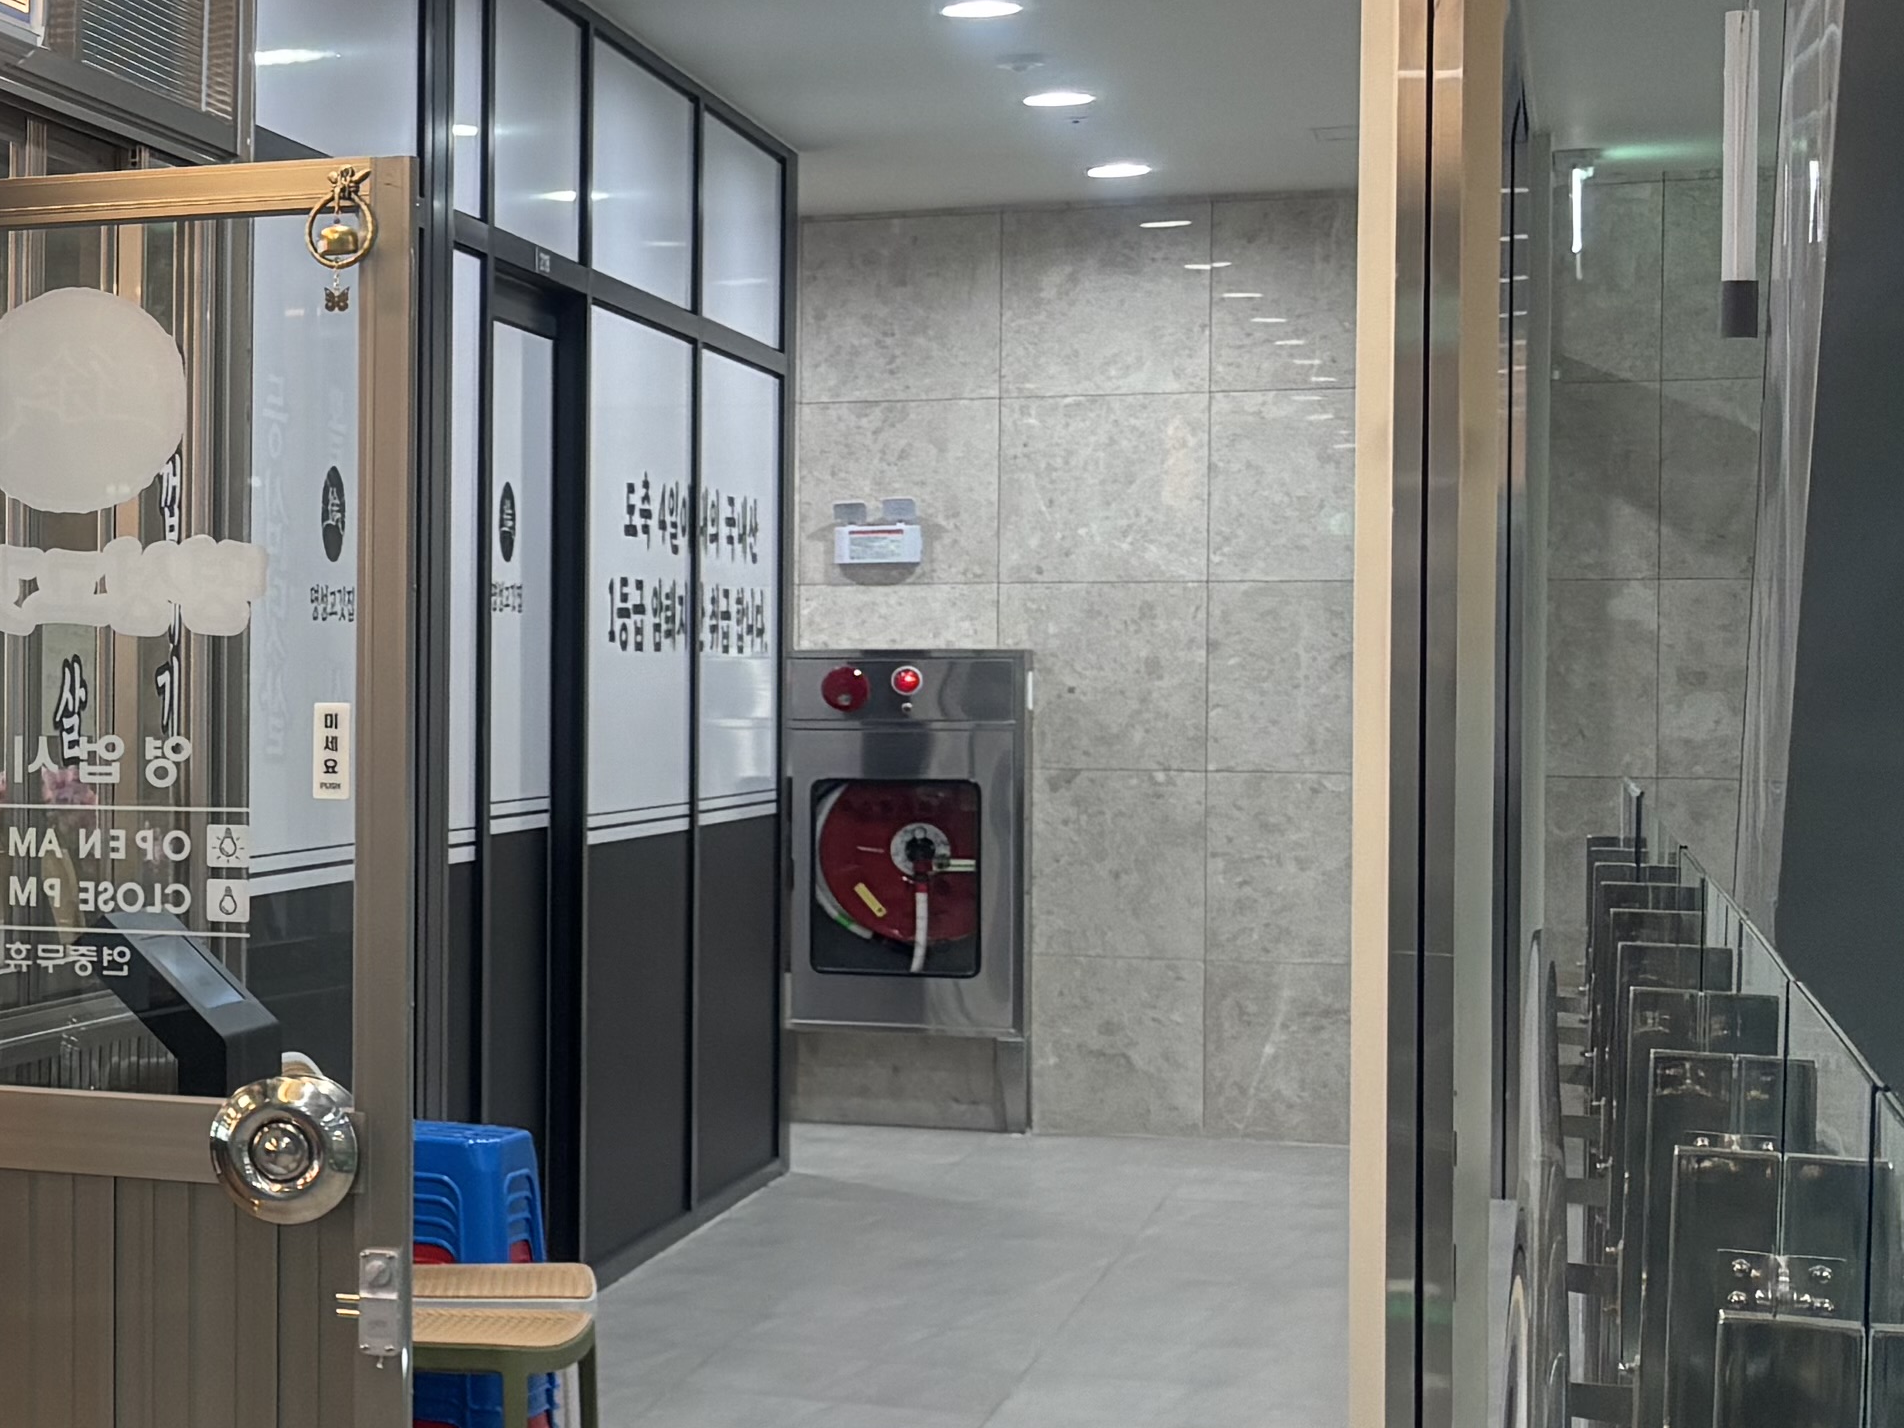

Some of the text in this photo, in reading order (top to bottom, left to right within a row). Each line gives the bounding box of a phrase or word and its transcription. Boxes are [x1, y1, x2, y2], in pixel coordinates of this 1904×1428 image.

[624, 471, 653, 556] 도축
[608, 576, 646, 652] 1등급
[322, 712, 339, 775] 미세요
